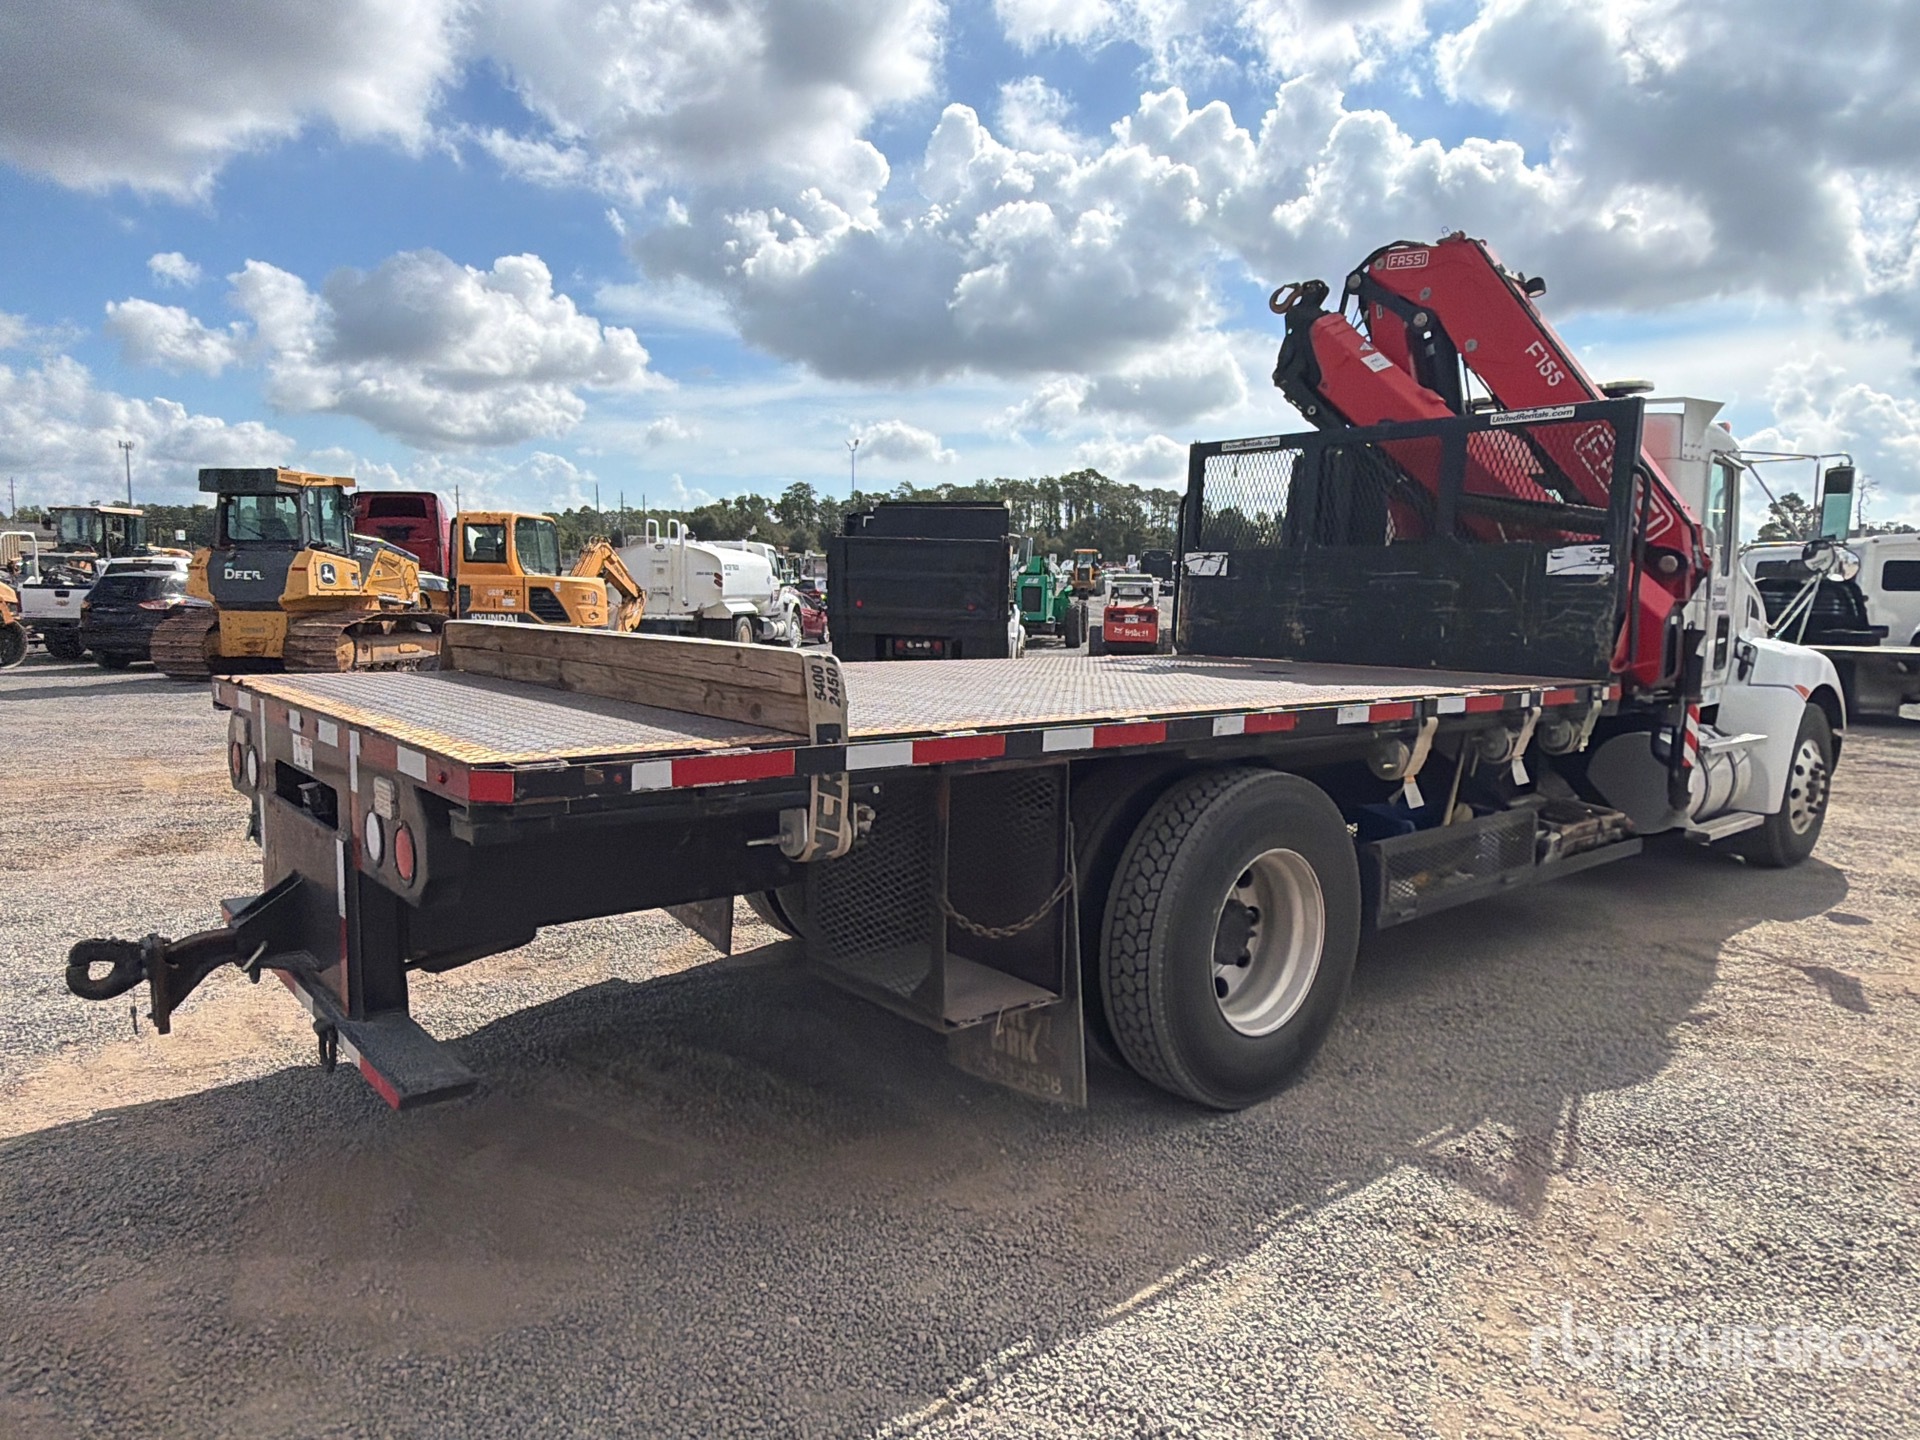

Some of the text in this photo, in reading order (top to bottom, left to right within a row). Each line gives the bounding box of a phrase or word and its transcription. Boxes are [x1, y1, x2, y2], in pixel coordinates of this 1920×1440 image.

[1390, 253, 1426, 267] FASSI
[1524, 340, 1565, 387] F155
[1491, 409, 1574, 423] UnitedRentals.com
[471, 613, 518, 623] HYUNDAI
[811, 665, 827, 701] 5400
[826, 667, 841, 708] 2450
